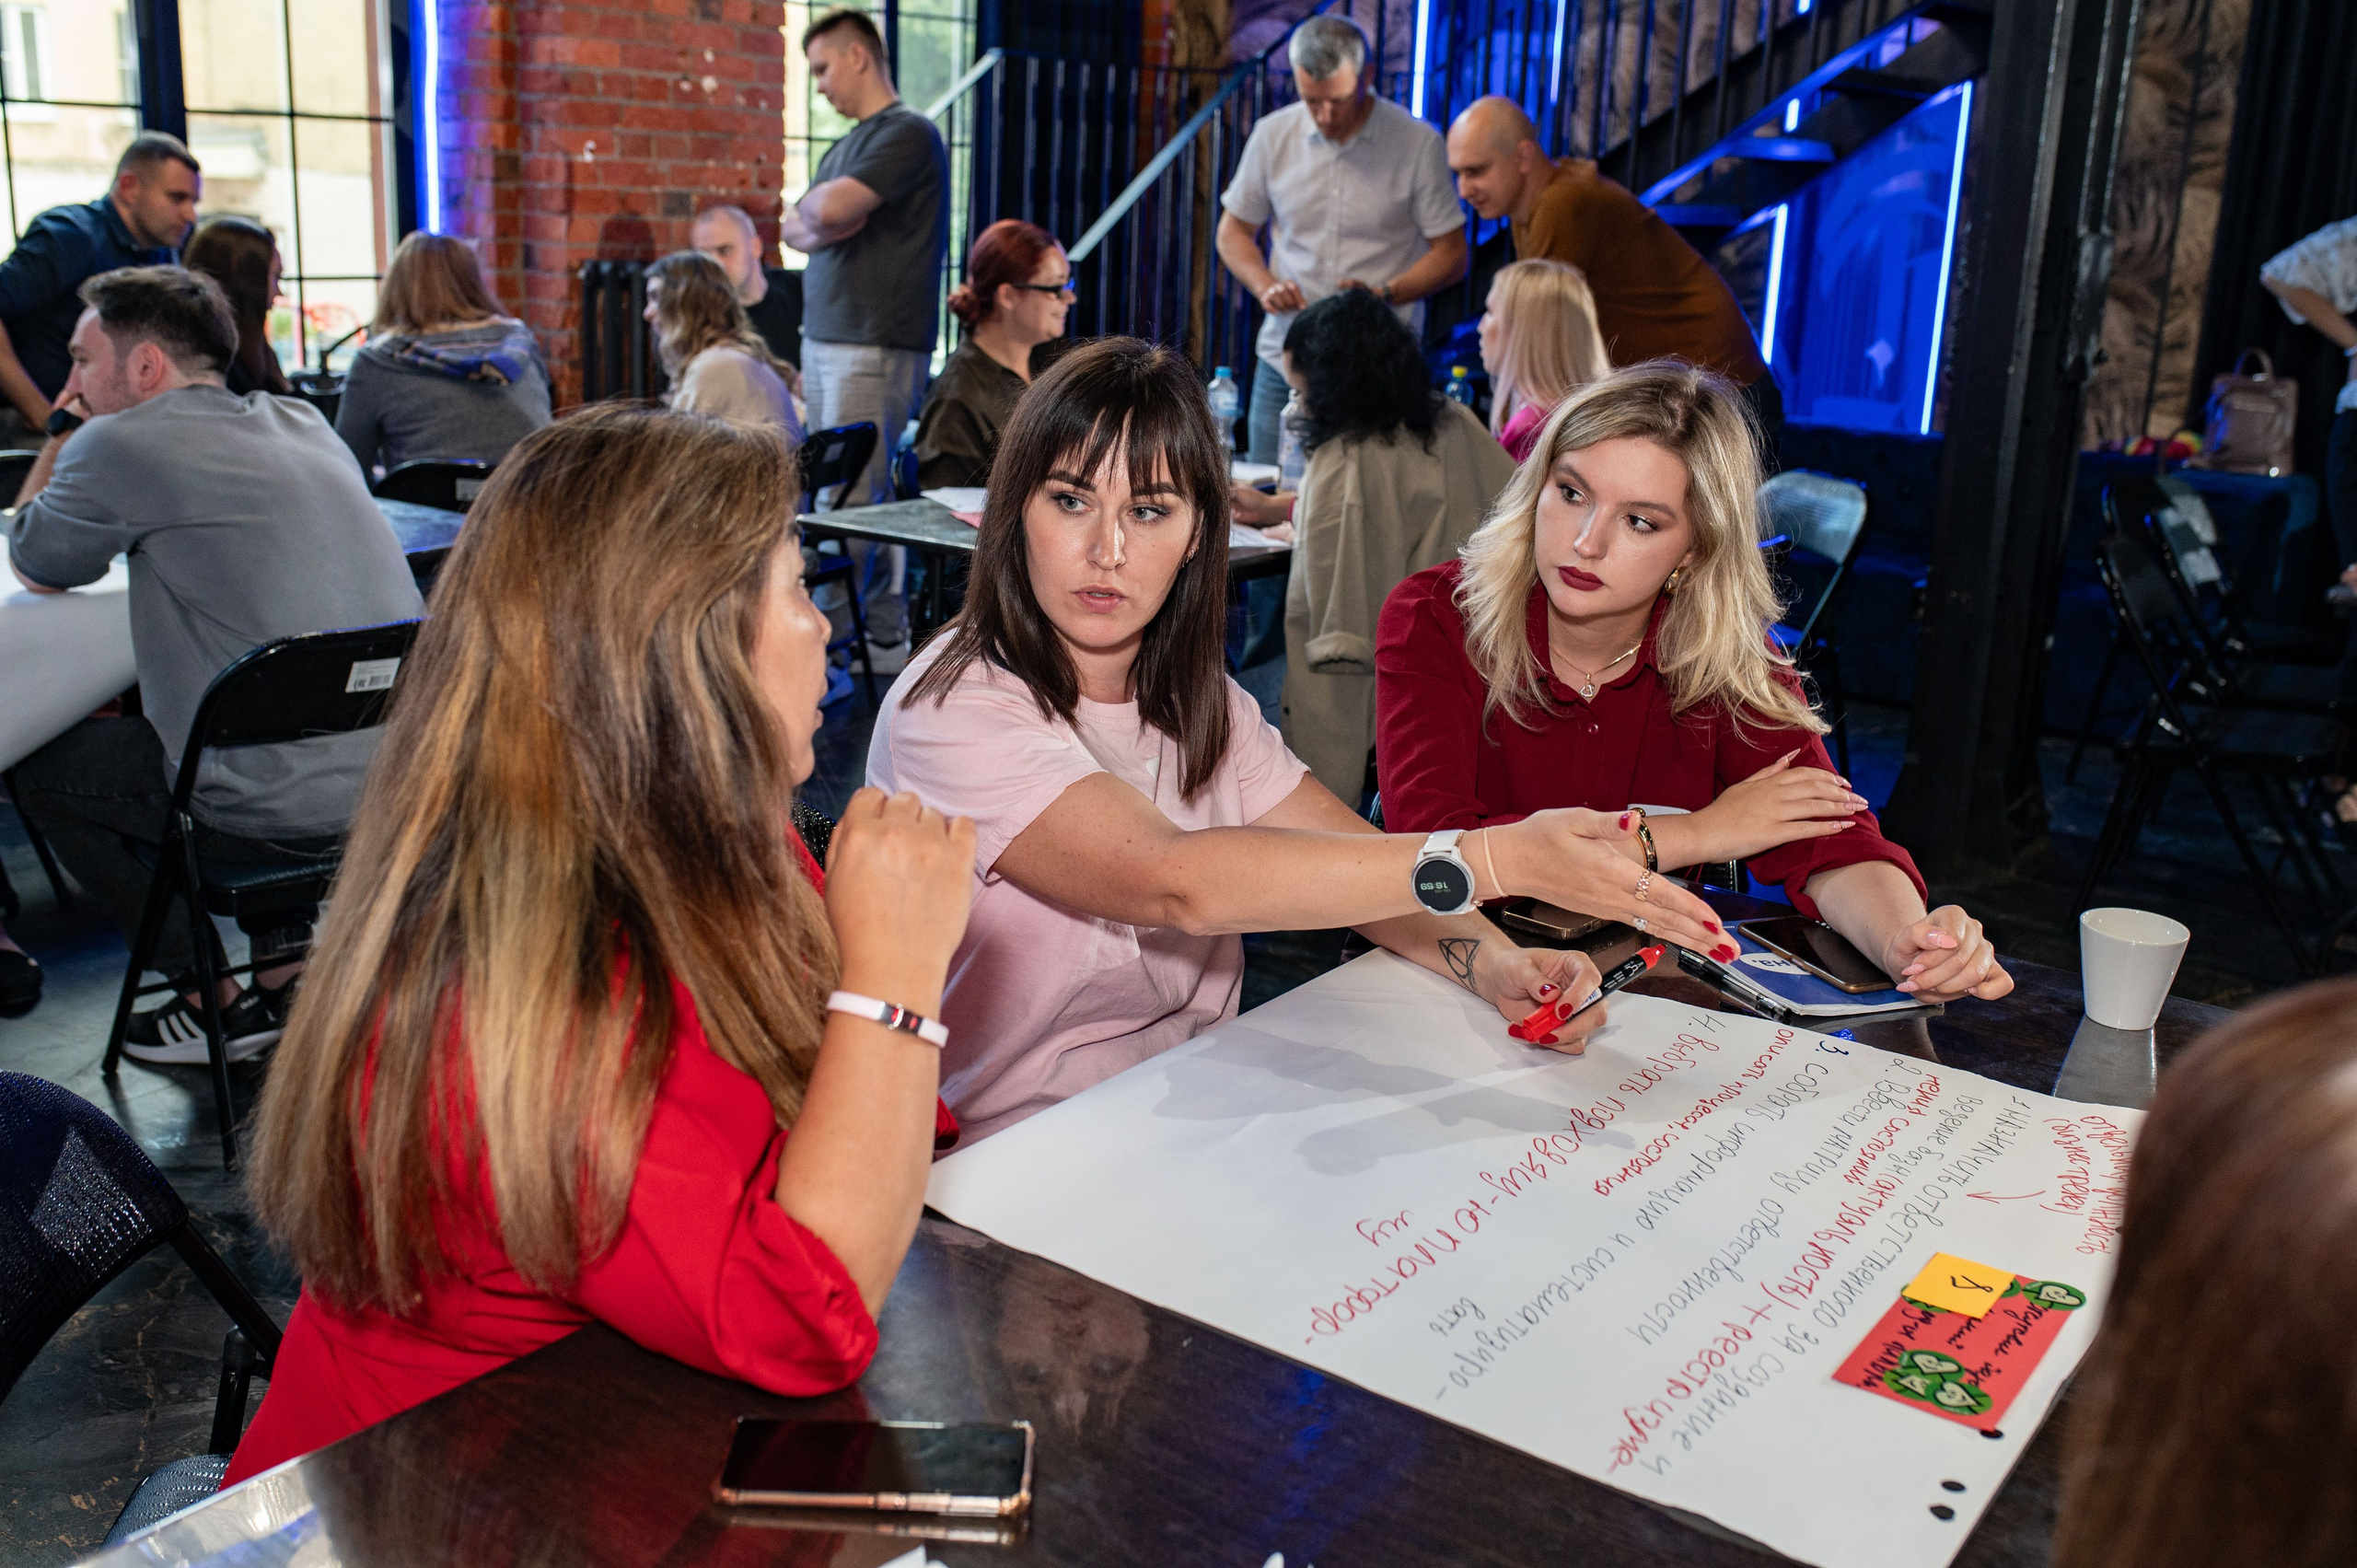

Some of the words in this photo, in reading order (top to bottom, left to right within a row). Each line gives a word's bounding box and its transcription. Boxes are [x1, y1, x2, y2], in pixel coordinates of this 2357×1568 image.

[1420, 881, 1447, 889] 16:59
[1688, 1014, 1726, 1032] 4.
[1618, 1032, 1720, 1095] выбрать
[1740, 1028, 1794, 1079] описать
[1815, 1040, 1850, 1055] 3.
[1884, 1058, 1922, 1074] 2.
[1744, 1063, 1829, 1121] собрать
[1635, 1121, 1755, 1230] информацию
[1355, 1209, 1412, 1247] му
[1607, 1233, 1635, 1248] и
[1625, 1198, 1784, 1345] ответственности
[1428, 1296, 1486, 1337] вать
[1435, 1247, 1615, 1400] систематизиро-
[1771, 1322, 1819, 1354] за
[1666, 1321, 1752, 1398] реестр
[1671, 1353, 1784, 1451] создание
[1640, 1455, 1671, 1475] и
